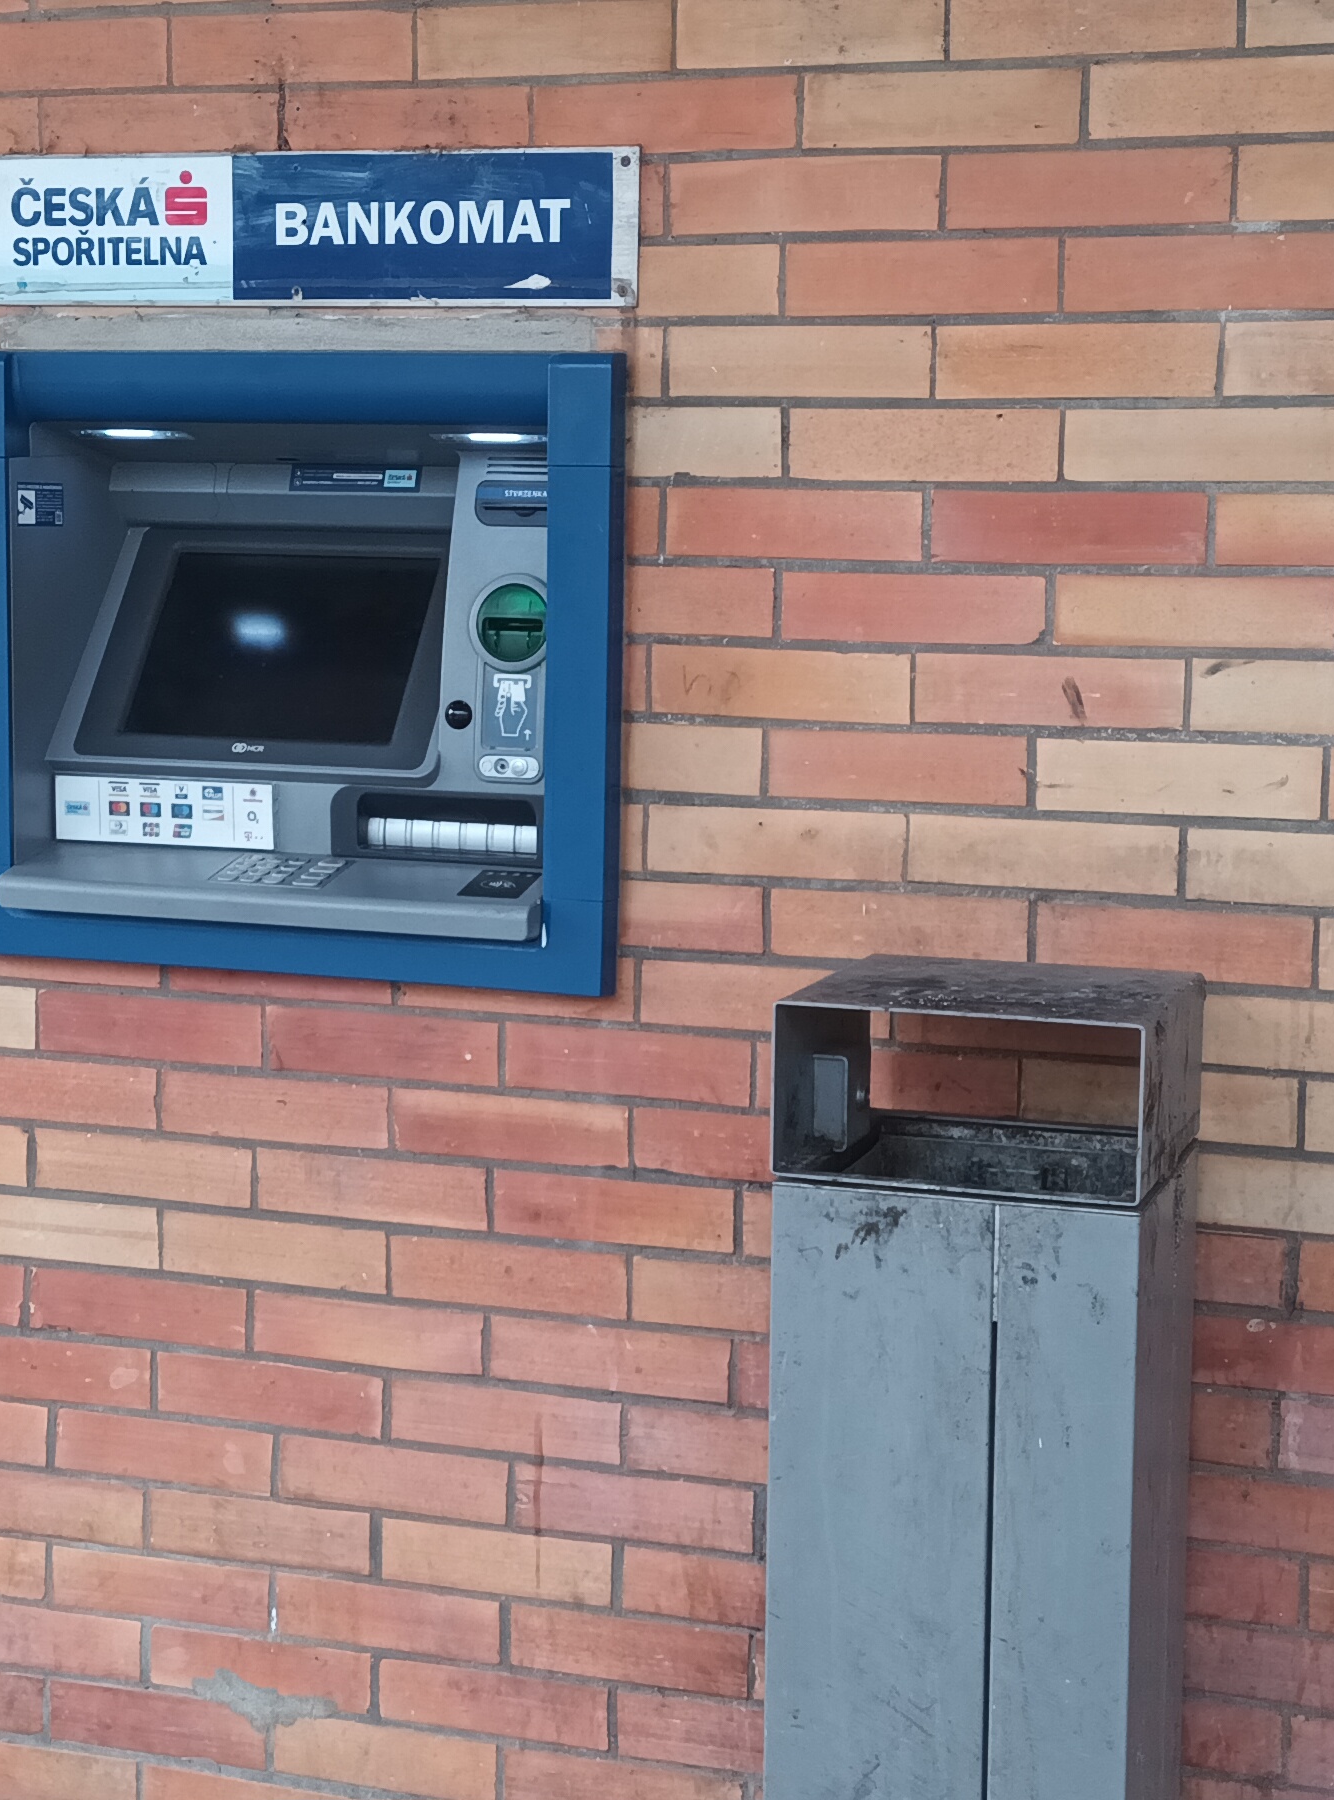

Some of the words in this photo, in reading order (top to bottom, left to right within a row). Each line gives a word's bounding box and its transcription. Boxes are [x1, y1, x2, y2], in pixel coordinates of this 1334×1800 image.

[10, 176, 159, 228] ČESKÁ
[275, 198, 571, 246] BANKOMAT
[12, 229, 208, 266] SPOŘITELNA
